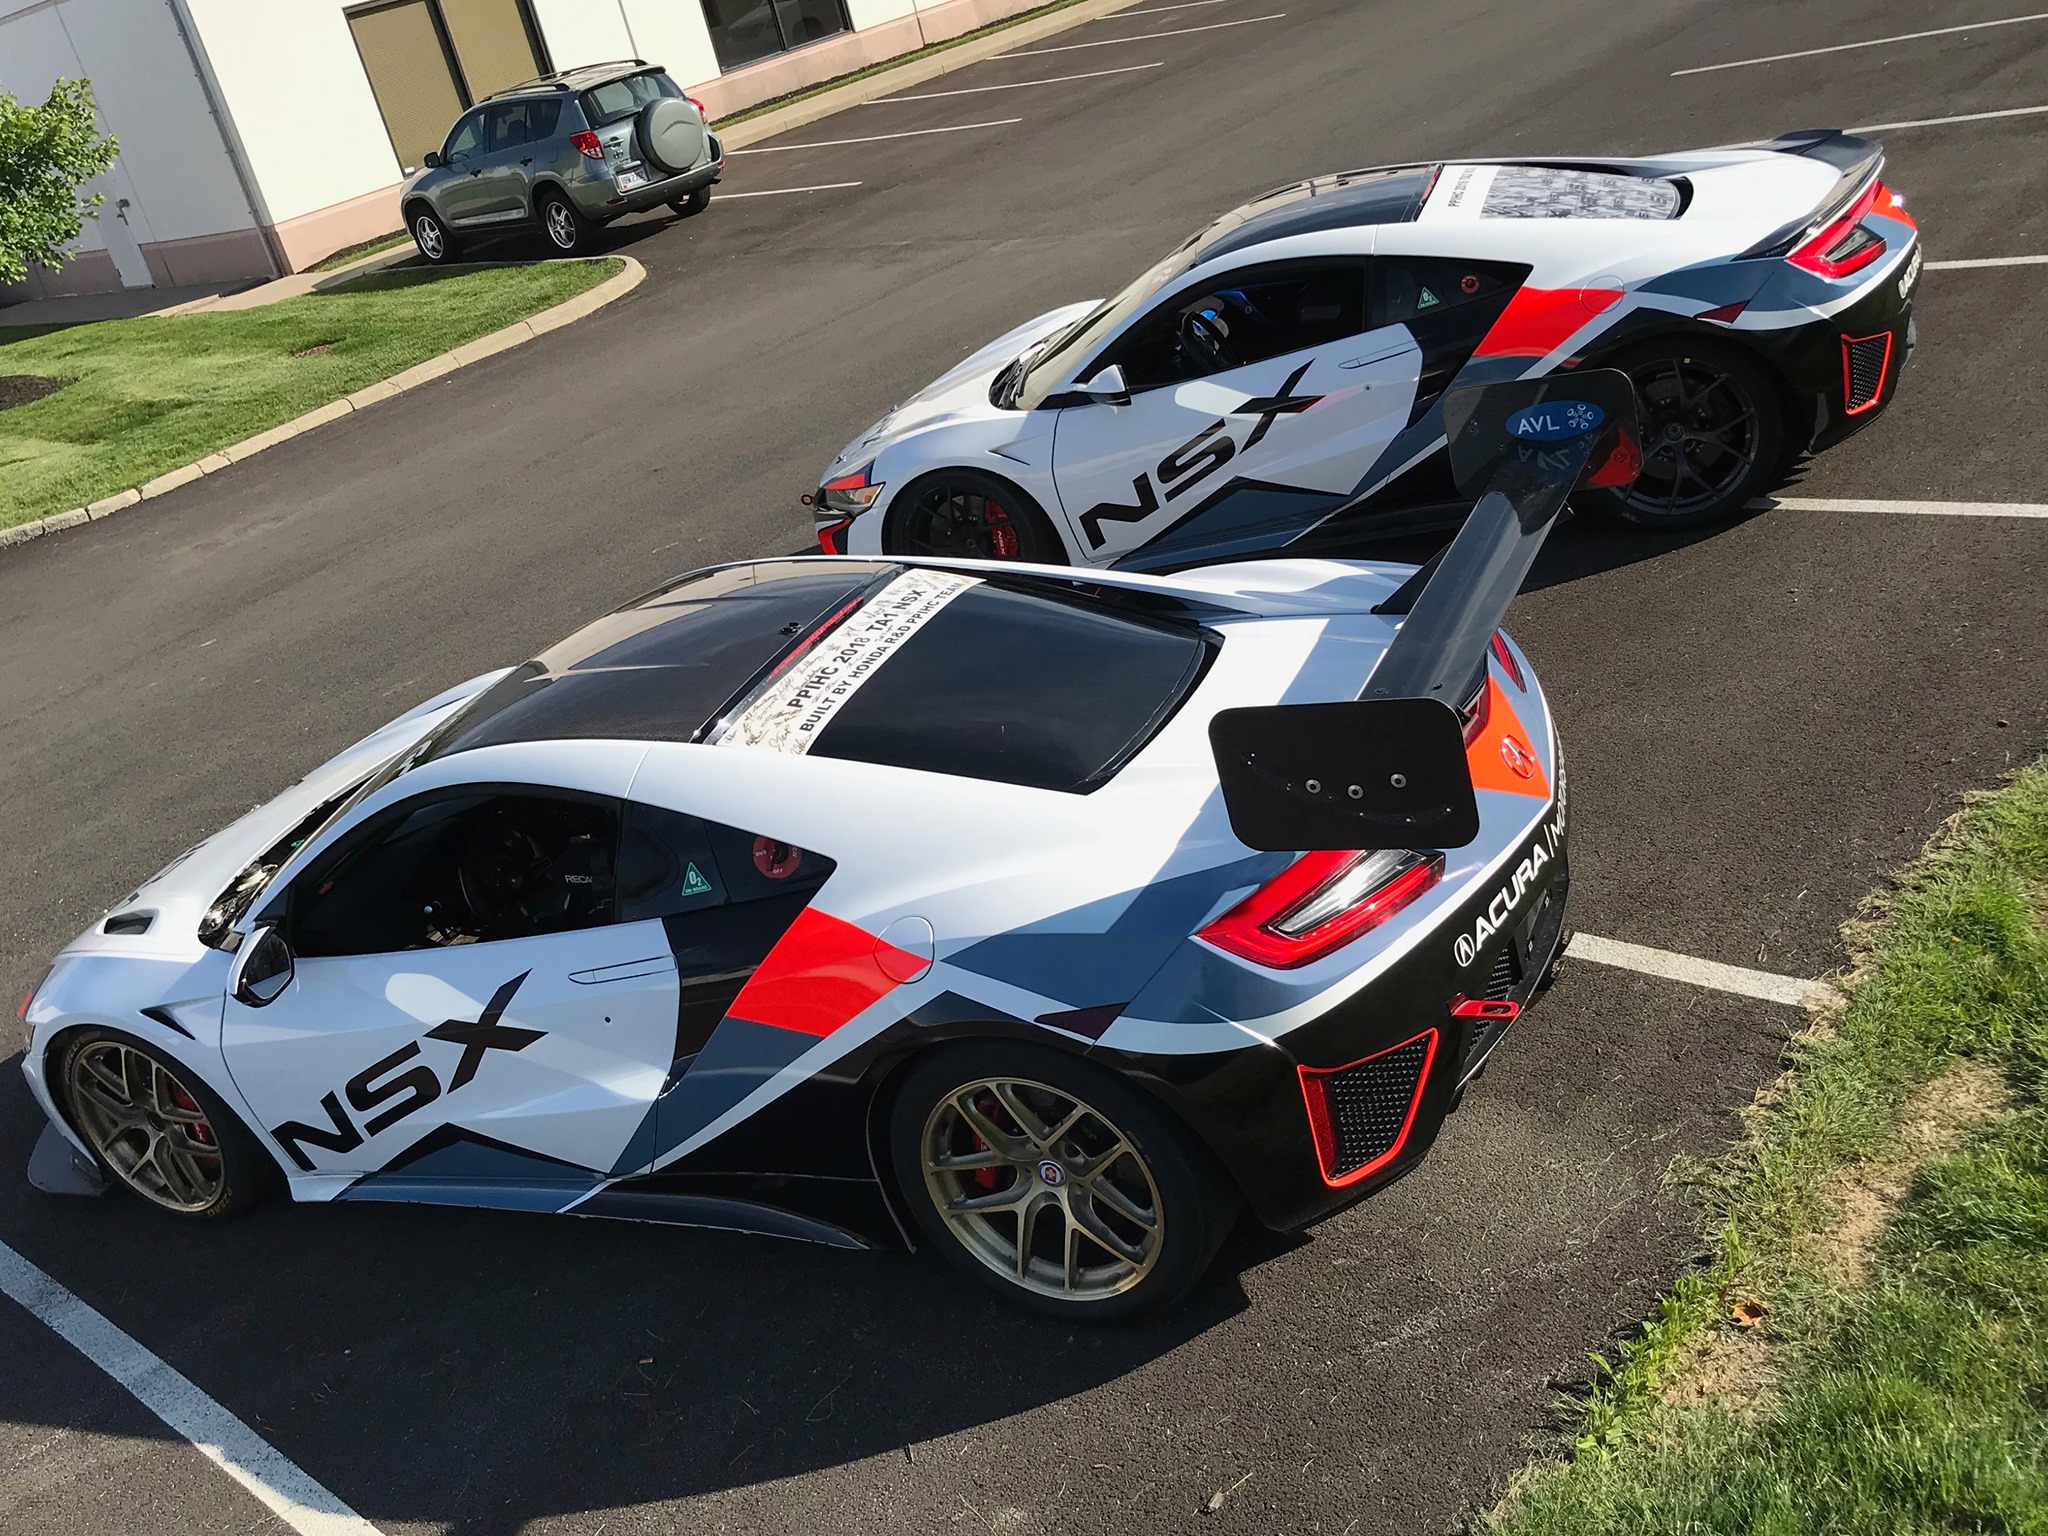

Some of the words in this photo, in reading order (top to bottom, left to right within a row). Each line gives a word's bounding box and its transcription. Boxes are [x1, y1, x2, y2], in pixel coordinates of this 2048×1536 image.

[1079, 357, 1326, 551] NSX
[1518, 415, 1560, 435] AVL
[786, 666, 839, 709] PPIHC
[832, 636, 871, 667] 2018
[865, 611, 900, 635] TA1
[898, 589, 928, 615] NSX
[800, 697, 837, 732] BUILT
[833, 680, 853, 698] BY
[847, 645, 888, 679] HONDA
[884, 624, 911, 648] R&D
[907, 599, 941, 630] PPIHC
[935, 581, 962, 604] TEAM
[564, 874, 593, 884] RECA
[1473, 843, 1549, 952] ACURA
[270, 968, 548, 1171] NSX
